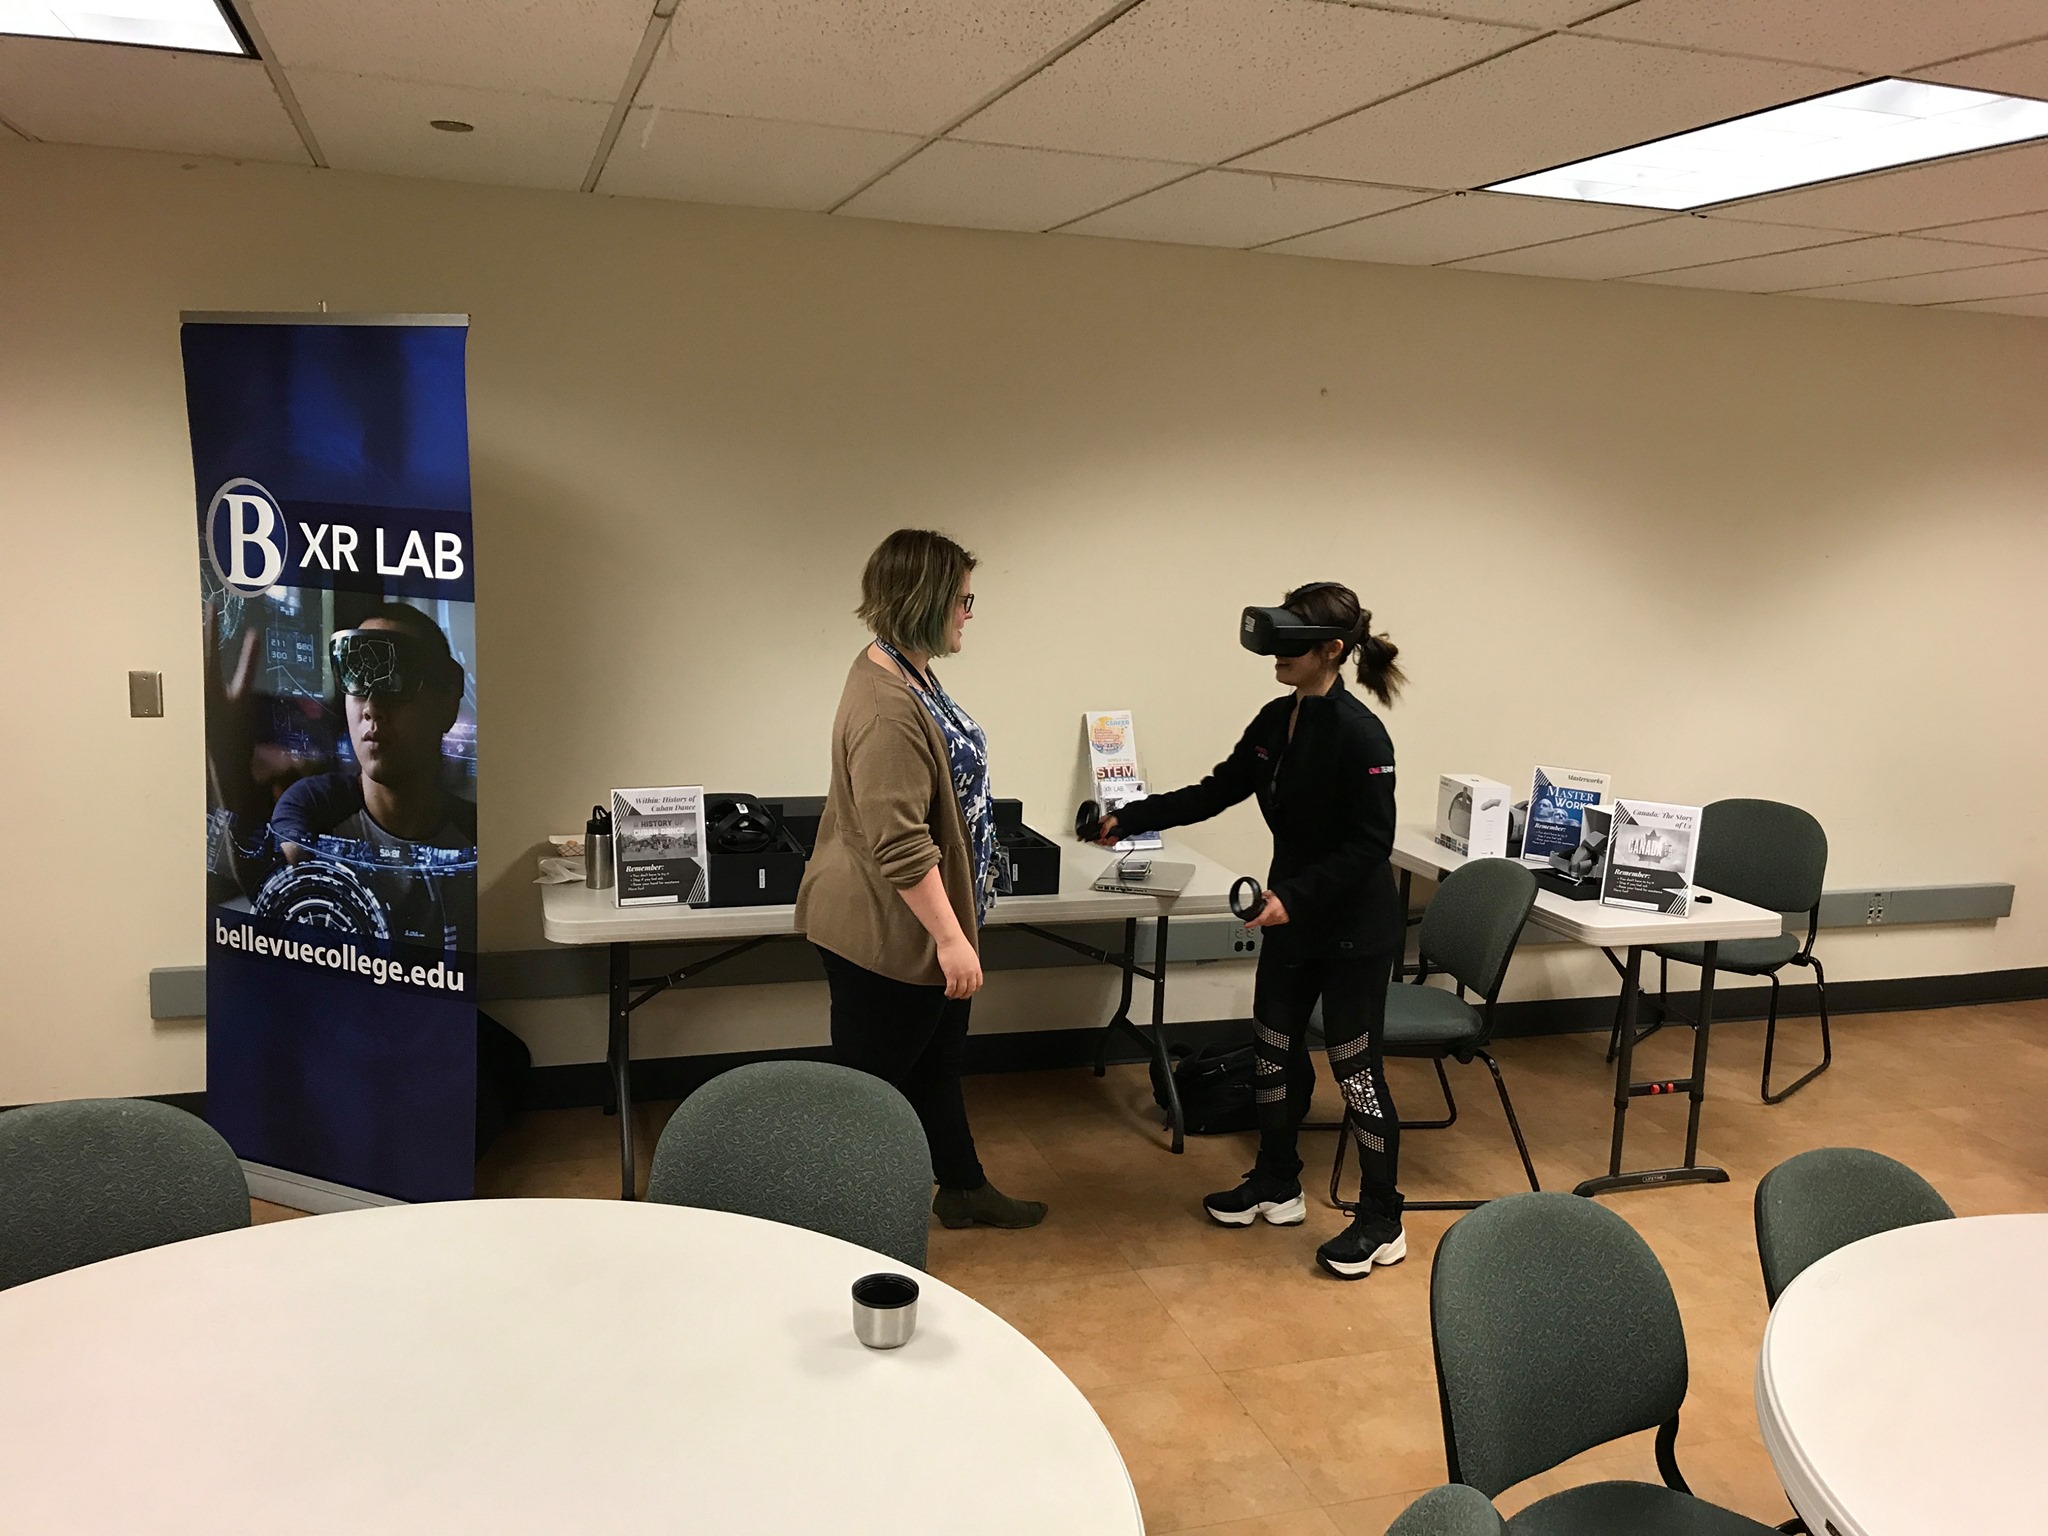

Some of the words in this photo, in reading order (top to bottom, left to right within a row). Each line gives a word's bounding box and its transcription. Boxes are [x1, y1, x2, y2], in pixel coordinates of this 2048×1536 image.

[223, 493, 282, 587] B
[299, 522, 359, 572] XR
[376, 528, 464, 580] LAB
[1096, 765, 1135, 778] STEM
[1568, 774, 1603, 784] Masterworks
[1546, 786, 1594, 802] MASTER
[636, 796, 661, 804] Within:
[662, 796, 688, 804] History
[688, 795, 696, 804] of
[1632, 810, 1660, 818] Canada:
[641, 820, 672, 828] HISTORY
[1534, 822, 1566, 832] Remember:
[634, 828, 658, 836] CUBAN
[661, 826, 686, 834] DANCE
[1628, 837, 1662, 857] CANADA
[626, 864, 664, 873] Remember:
[1614, 868, 1651, 880] Remember:
[215, 918, 464, 992] bellevuecollege.edu
